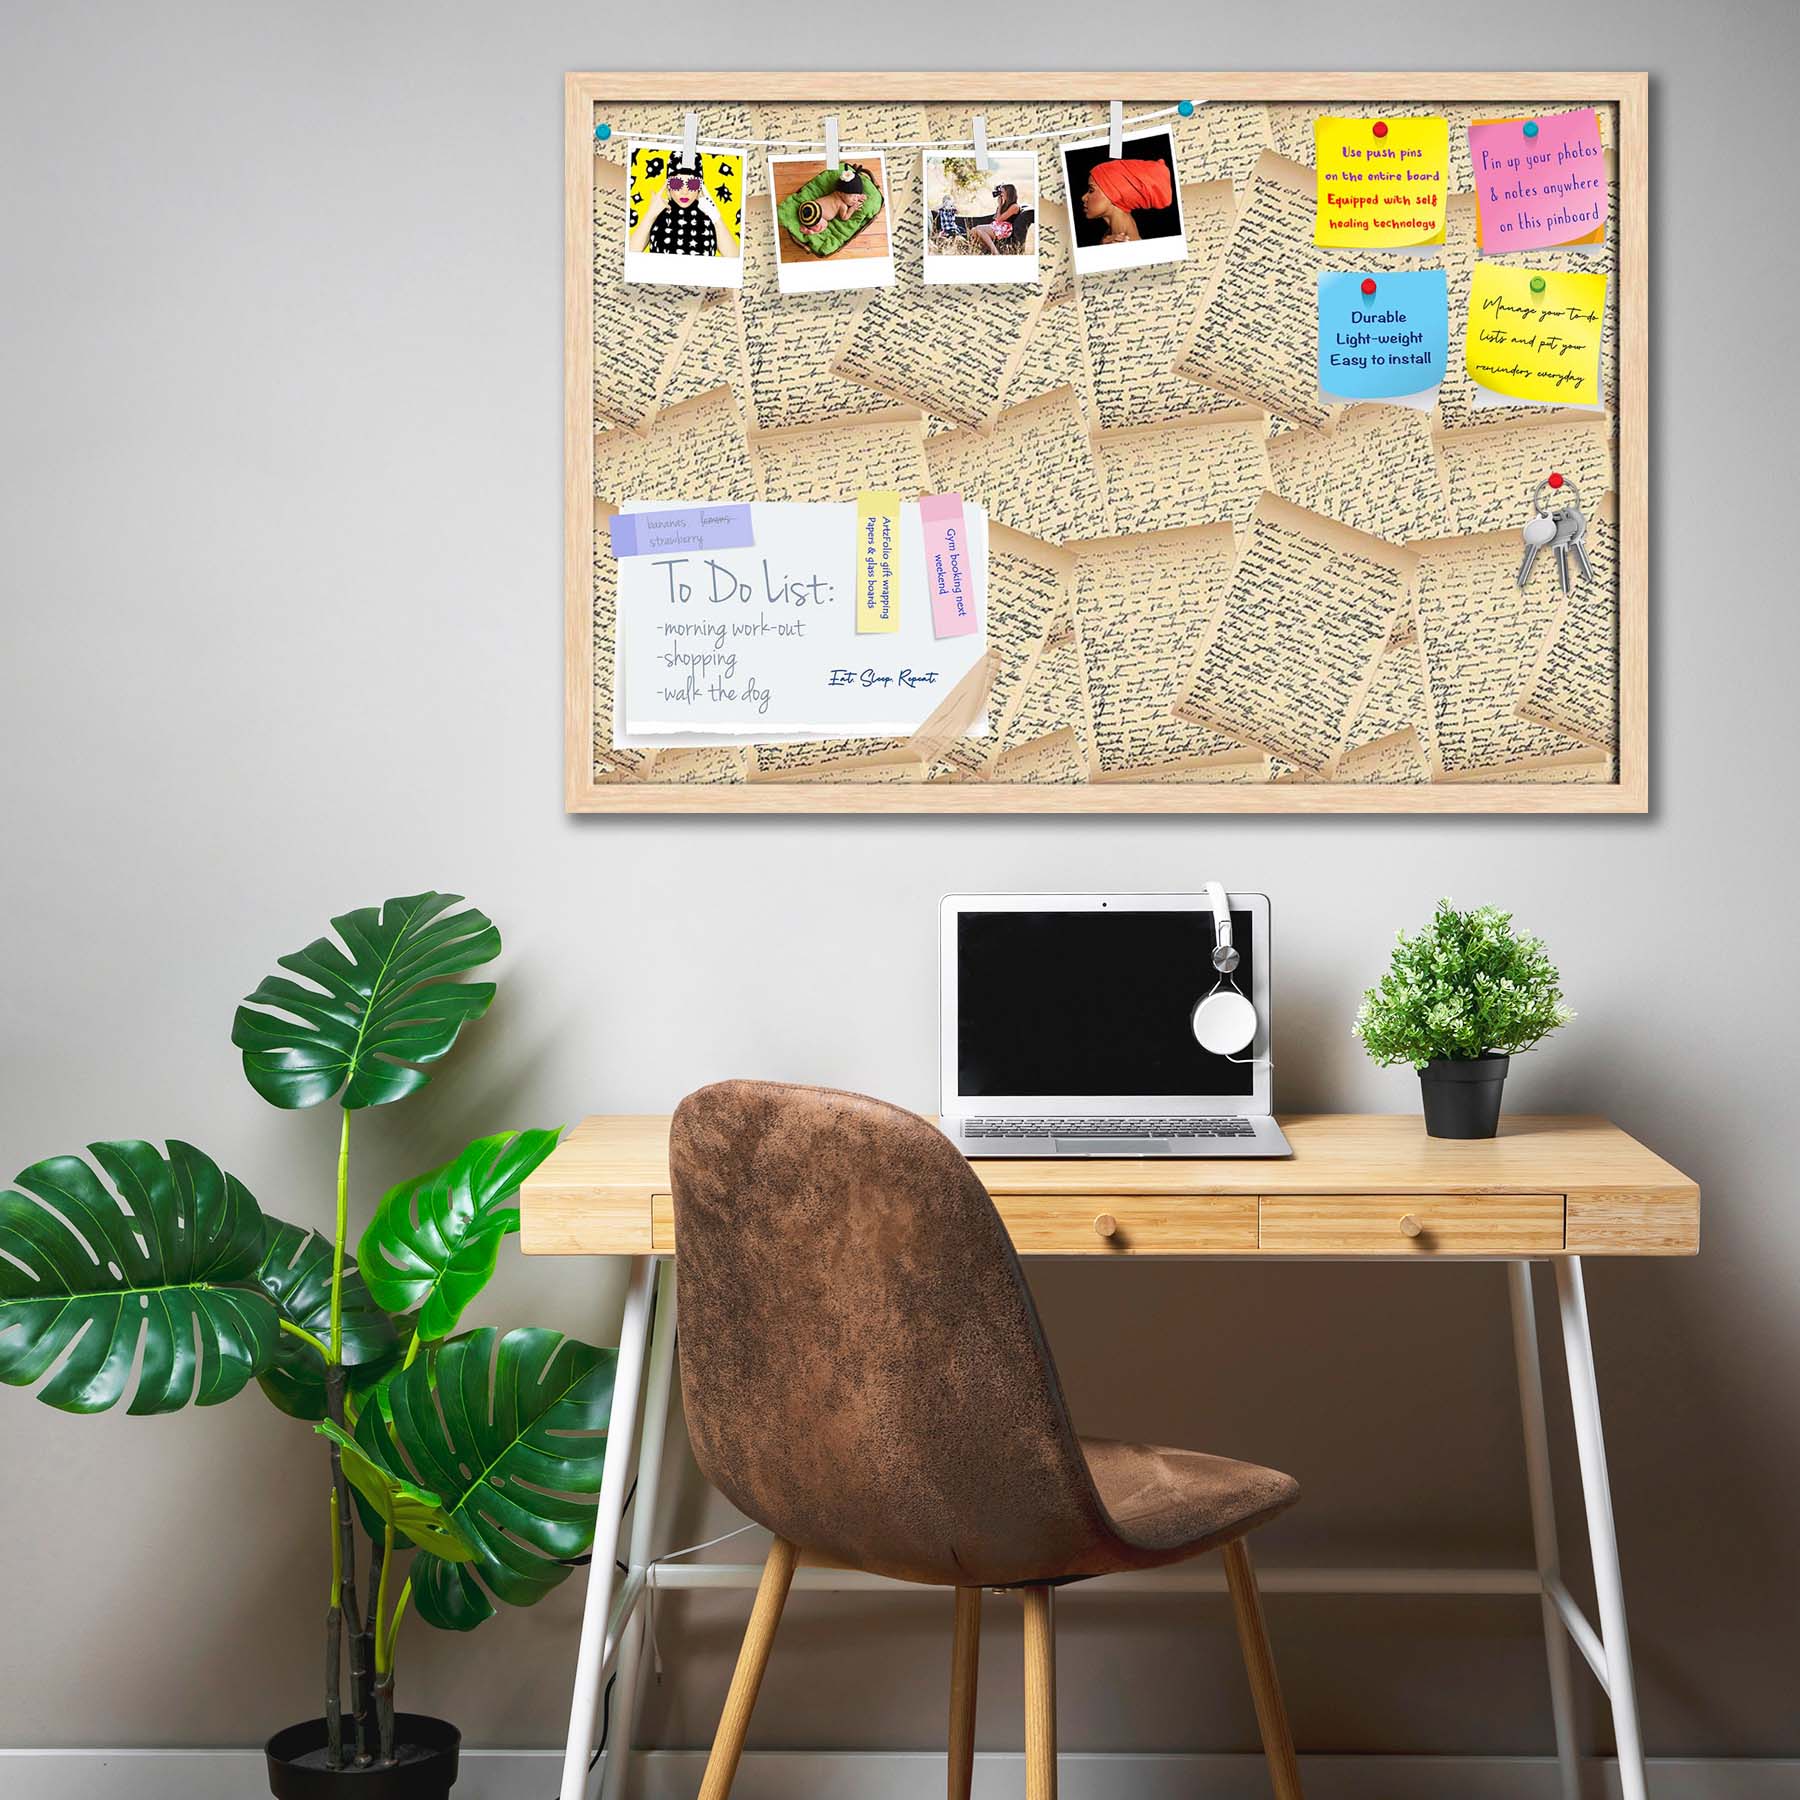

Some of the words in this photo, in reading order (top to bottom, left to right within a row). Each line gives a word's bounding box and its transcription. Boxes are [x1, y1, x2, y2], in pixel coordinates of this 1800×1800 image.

[1342, 146, 1362, 158] Use
[1366, 148, 1396, 161] push
[1400, 148, 1423, 161] pins
[1482, 150, 1502, 171] Pin
[1507, 157, 1521, 171] up
[1526, 153, 1551, 169] your
[1557, 140, 1598, 165] photos
[1325, 173, 1338, 181] on
[1342, 171, 1363, 182] the
[1367, 171, 1402, 181] entire
[1407, 170, 1440, 181] board
[1490, 186, 1498, 202] &
[1504, 181, 1537, 200] notes
[1543, 173, 1599, 198] anywhere
[1327, 193, 1379, 208] Equipped
[1384, 195, 1411, 206] with
[1415, 194, 1438, 207] self
[1329, 218, 1369, 230] healing
[1373, 218, 1436, 231] technology
[1500, 223, 1513, 233] on
[1518, 211, 1541, 230] this
[1547, 202, 1599, 231] pinboard
[1351, 310, 1407, 324] Durable
[1482, 295, 1537, 320] Manage
[1540, 310, 1565, 323] your
[1336, 331, 1423, 348] Light-weight
[1511, 335, 1536, 348] and
[1538, 336, 1563, 353] put
[1561, 342, 1586, 356] your
[1330, 353, 1367, 369] Easy
[1371, 354, 1385, 366] to
[1388, 352, 1432, 365] install
[1476, 364, 1533, 378] reminders
[1536, 370, 1585, 389] everyday
[649, 529, 704, 550] strawberry
[865, 516, 877, 545] Papers
[881, 516, 893, 560] ArtzFolio
[944, 528, 957, 551] Gym
[866, 546, 876, 555] &
[865, 556, 877, 578] glass
[880, 562, 893, 578] gift
[934, 554, 950, 596] weekend
[949, 553, 963, 594] booking
[651, 559, 692, 603] To
[704, 559, 752, 603] Do
[763, 559, 834, 607] List:
[866, 579, 877, 609] boards
[880, 579, 891, 620] wrapping
[955, 596, 967, 617] next
[656, 620, 727, 649] -morning
[732, 611, 806, 638] work-out
[656, 639, 737, 679] -shopping
[656, 675, 702, 705] -walk
[708, 674, 738, 702] the
[741, 677, 772, 714] dog
